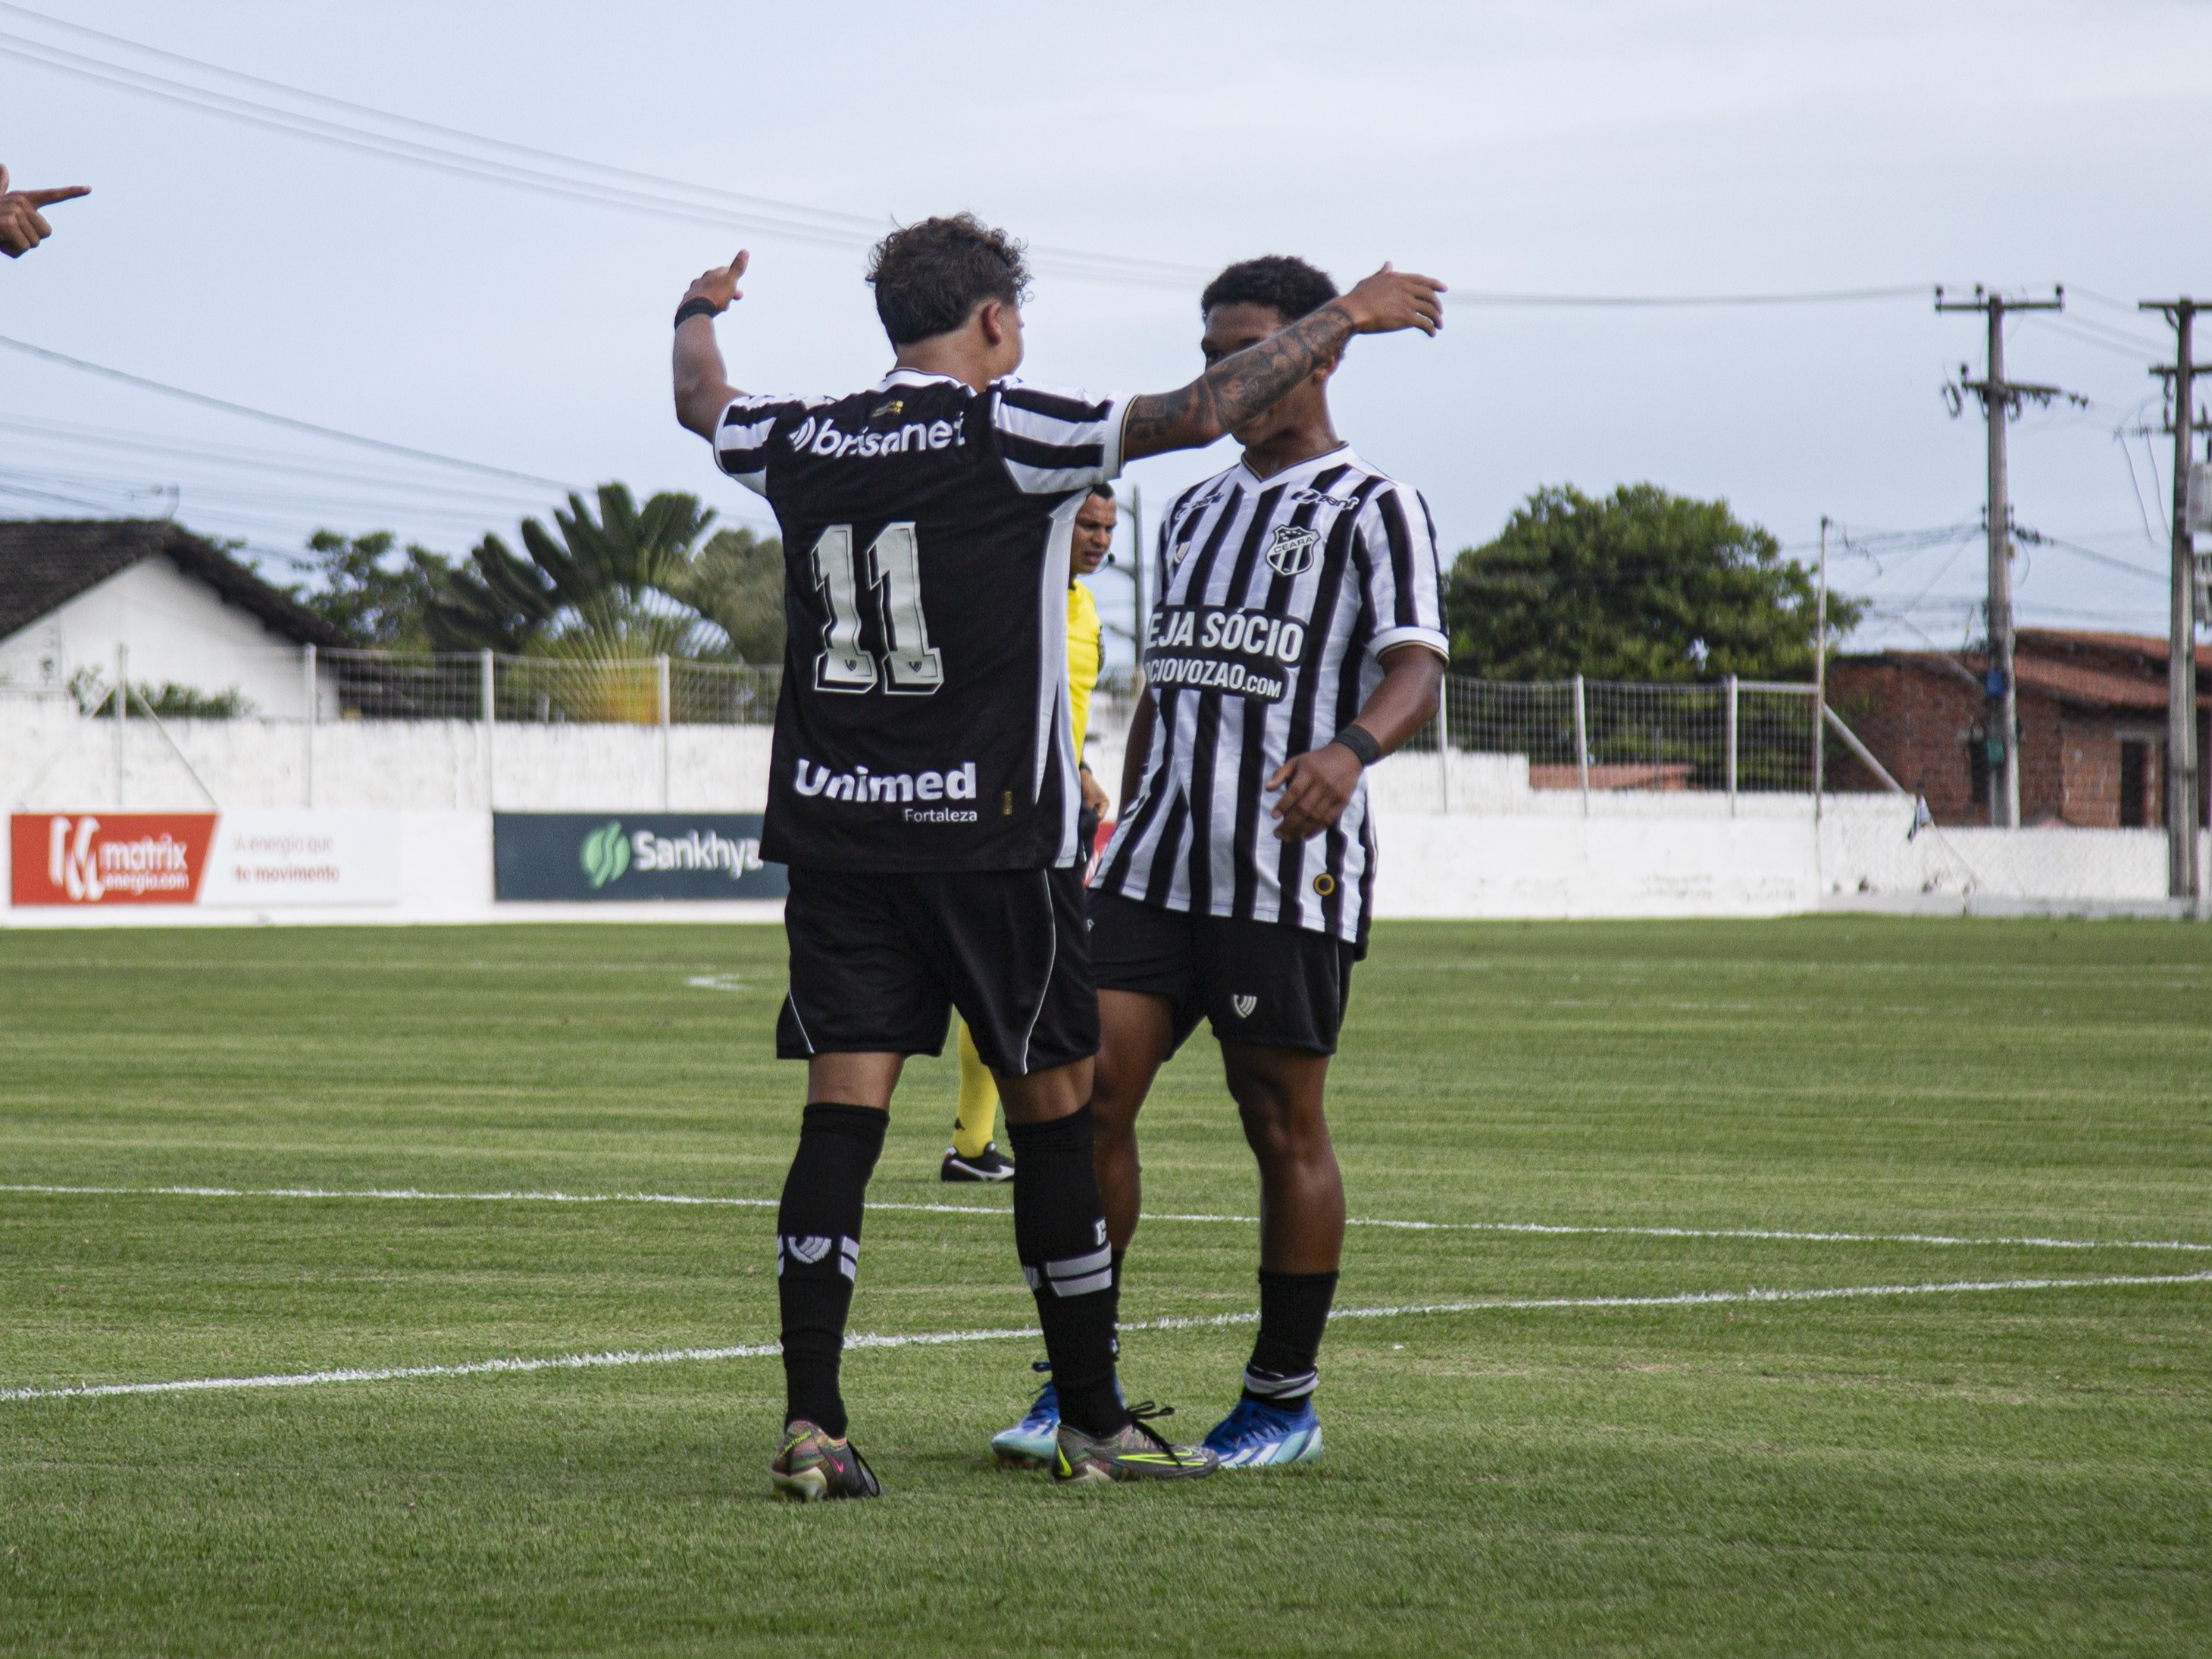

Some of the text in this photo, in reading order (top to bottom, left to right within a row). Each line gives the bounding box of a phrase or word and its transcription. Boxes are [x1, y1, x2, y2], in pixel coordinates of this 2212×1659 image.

[810, 412, 965, 458] brisanet
[811, 521, 945, 695] 11
[1201, 607, 1304, 662] SÓCIO
[795, 758, 977, 803] Unimed
[904, 808, 978, 822] Fortaleza
[99, 834, 189, 871] matrix
[632, 828, 764, 880] Sankhya
